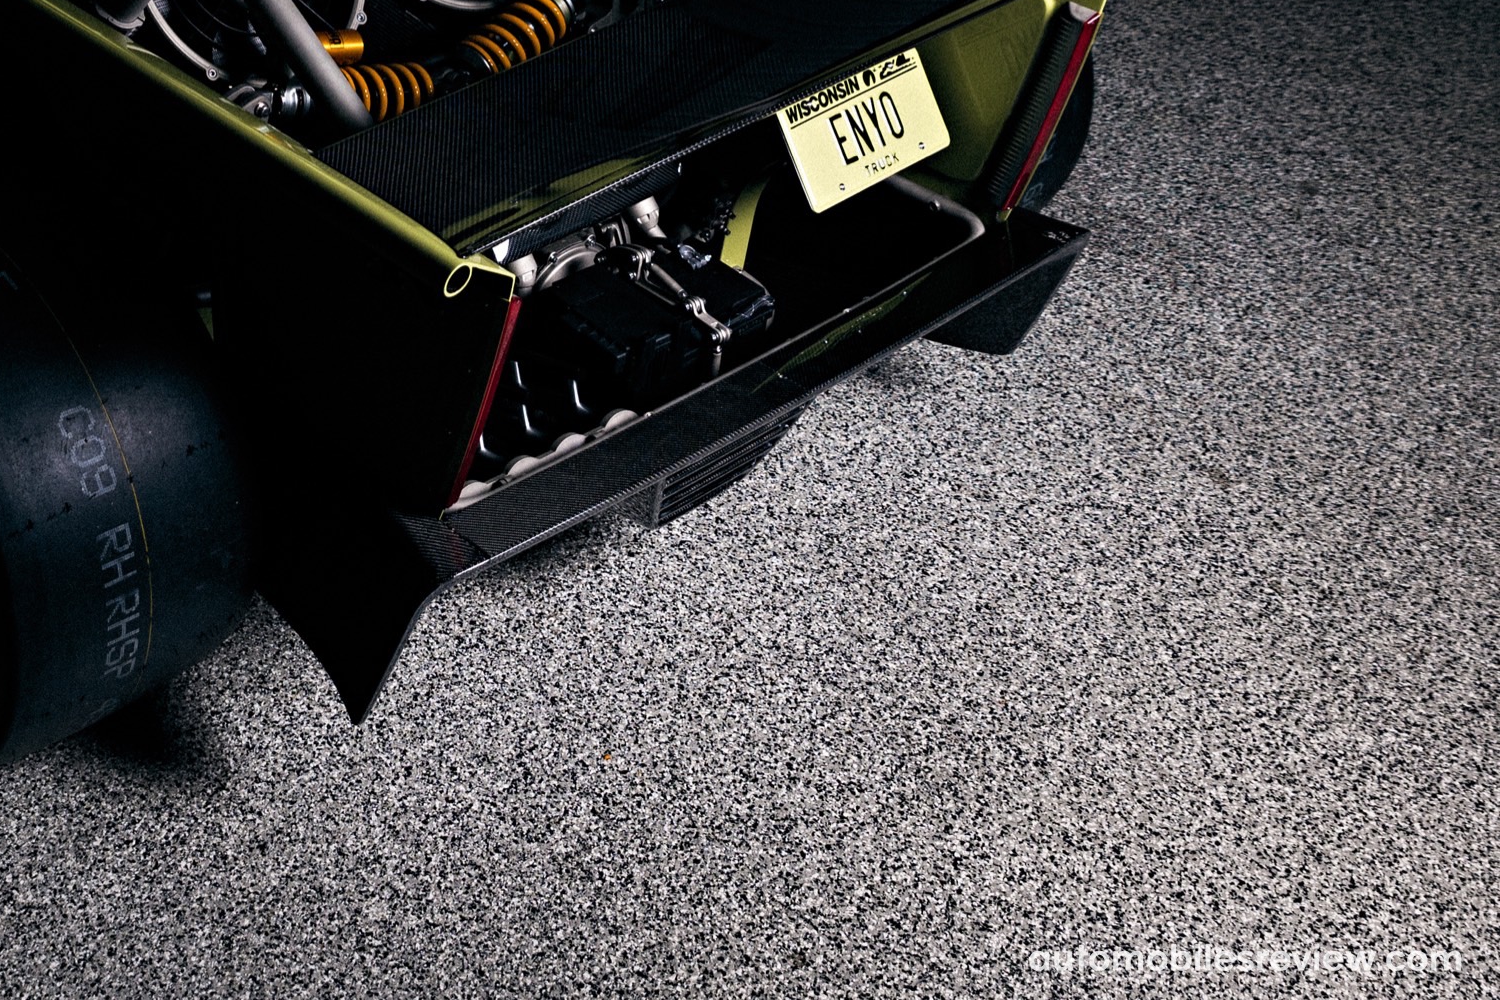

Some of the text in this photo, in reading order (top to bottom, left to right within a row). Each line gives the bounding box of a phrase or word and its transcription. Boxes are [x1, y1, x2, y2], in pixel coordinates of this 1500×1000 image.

[785, 75, 860, 124] WISCONSIN
[828, 91, 905, 166] ENYO
[864, 152, 900, 177] TRUCK
[57, 405, 118, 498] C09
[96, 522, 138, 588] RH
